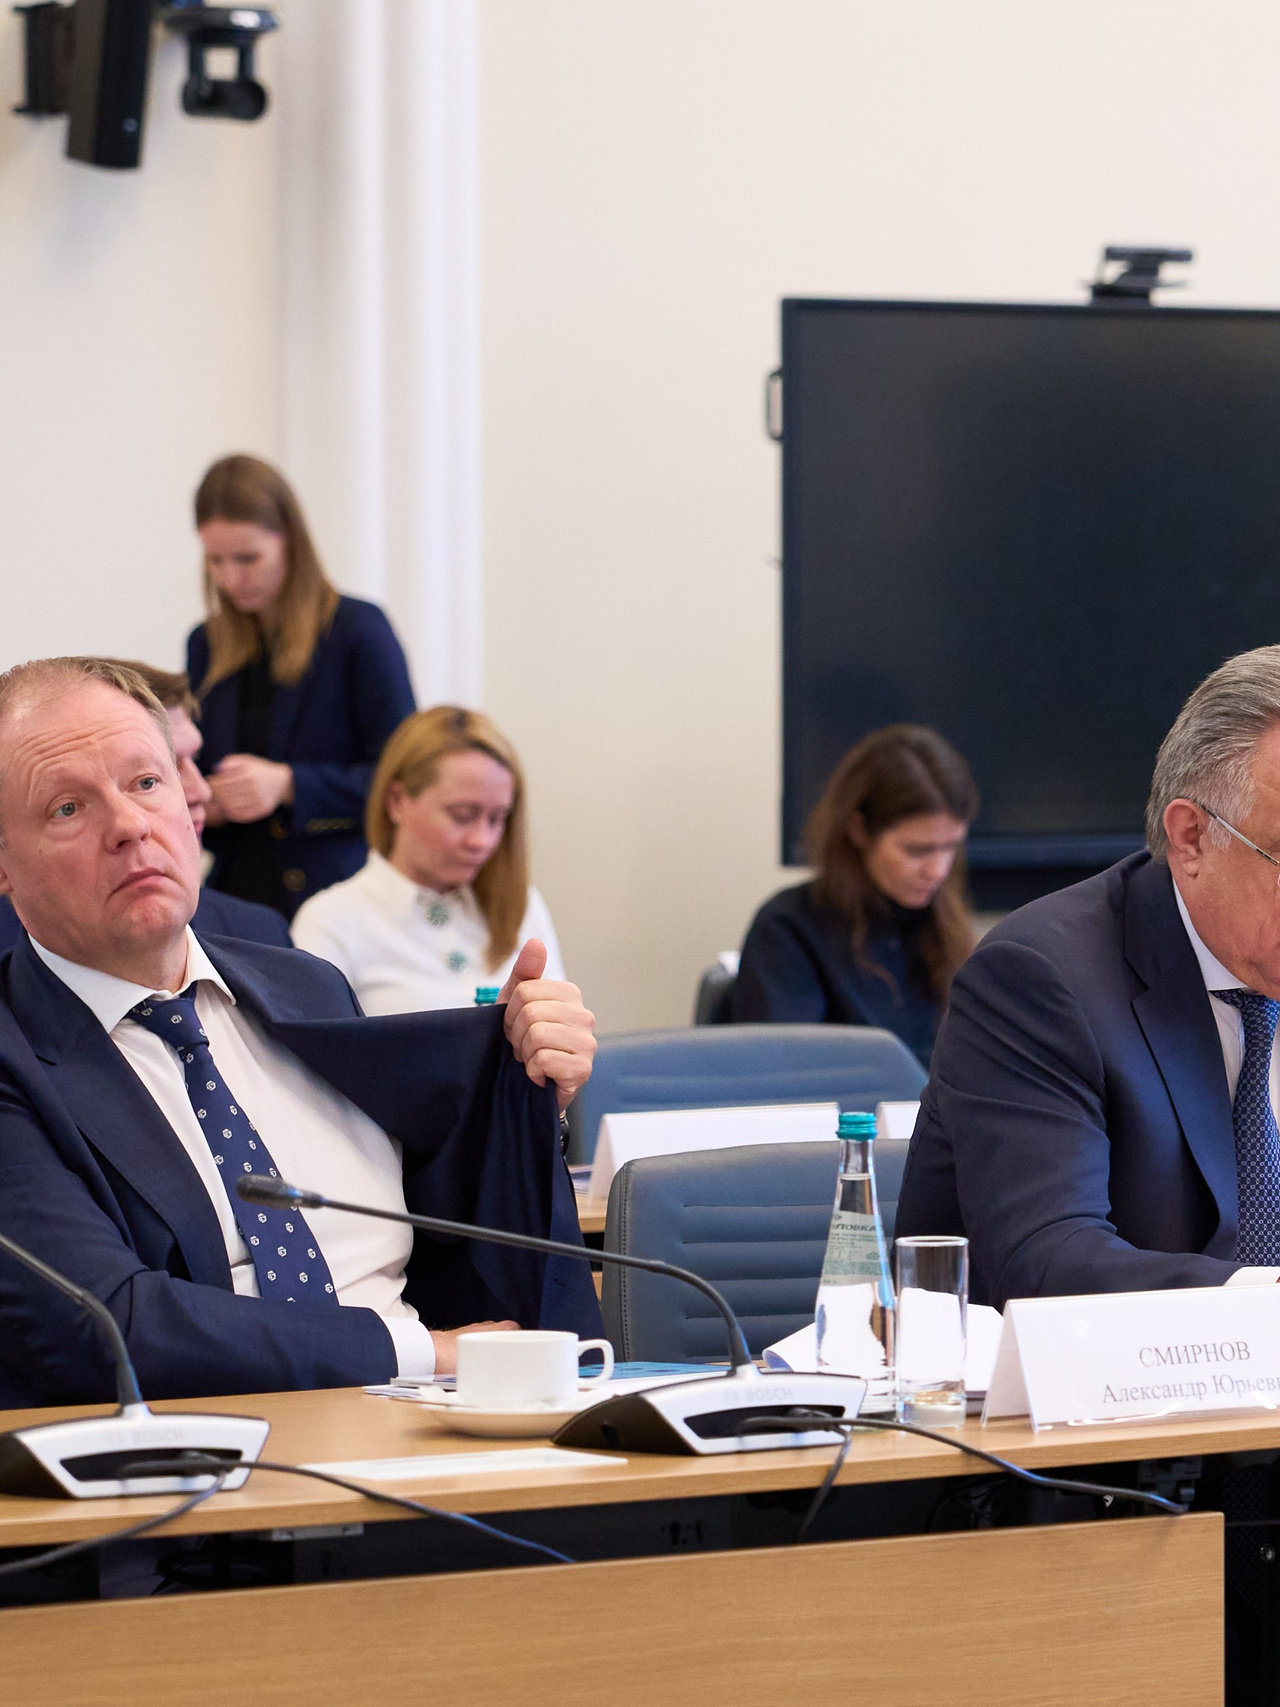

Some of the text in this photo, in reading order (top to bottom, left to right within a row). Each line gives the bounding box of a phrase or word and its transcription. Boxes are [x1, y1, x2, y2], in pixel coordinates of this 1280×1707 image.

[1139, 1341, 1251, 1368] СМИРНОВ
[746, 1387, 792, 1402] BOSCH
[1102, 1379, 1207, 1404] Александр
[132, 1428, 184, 1443] BOSCH
